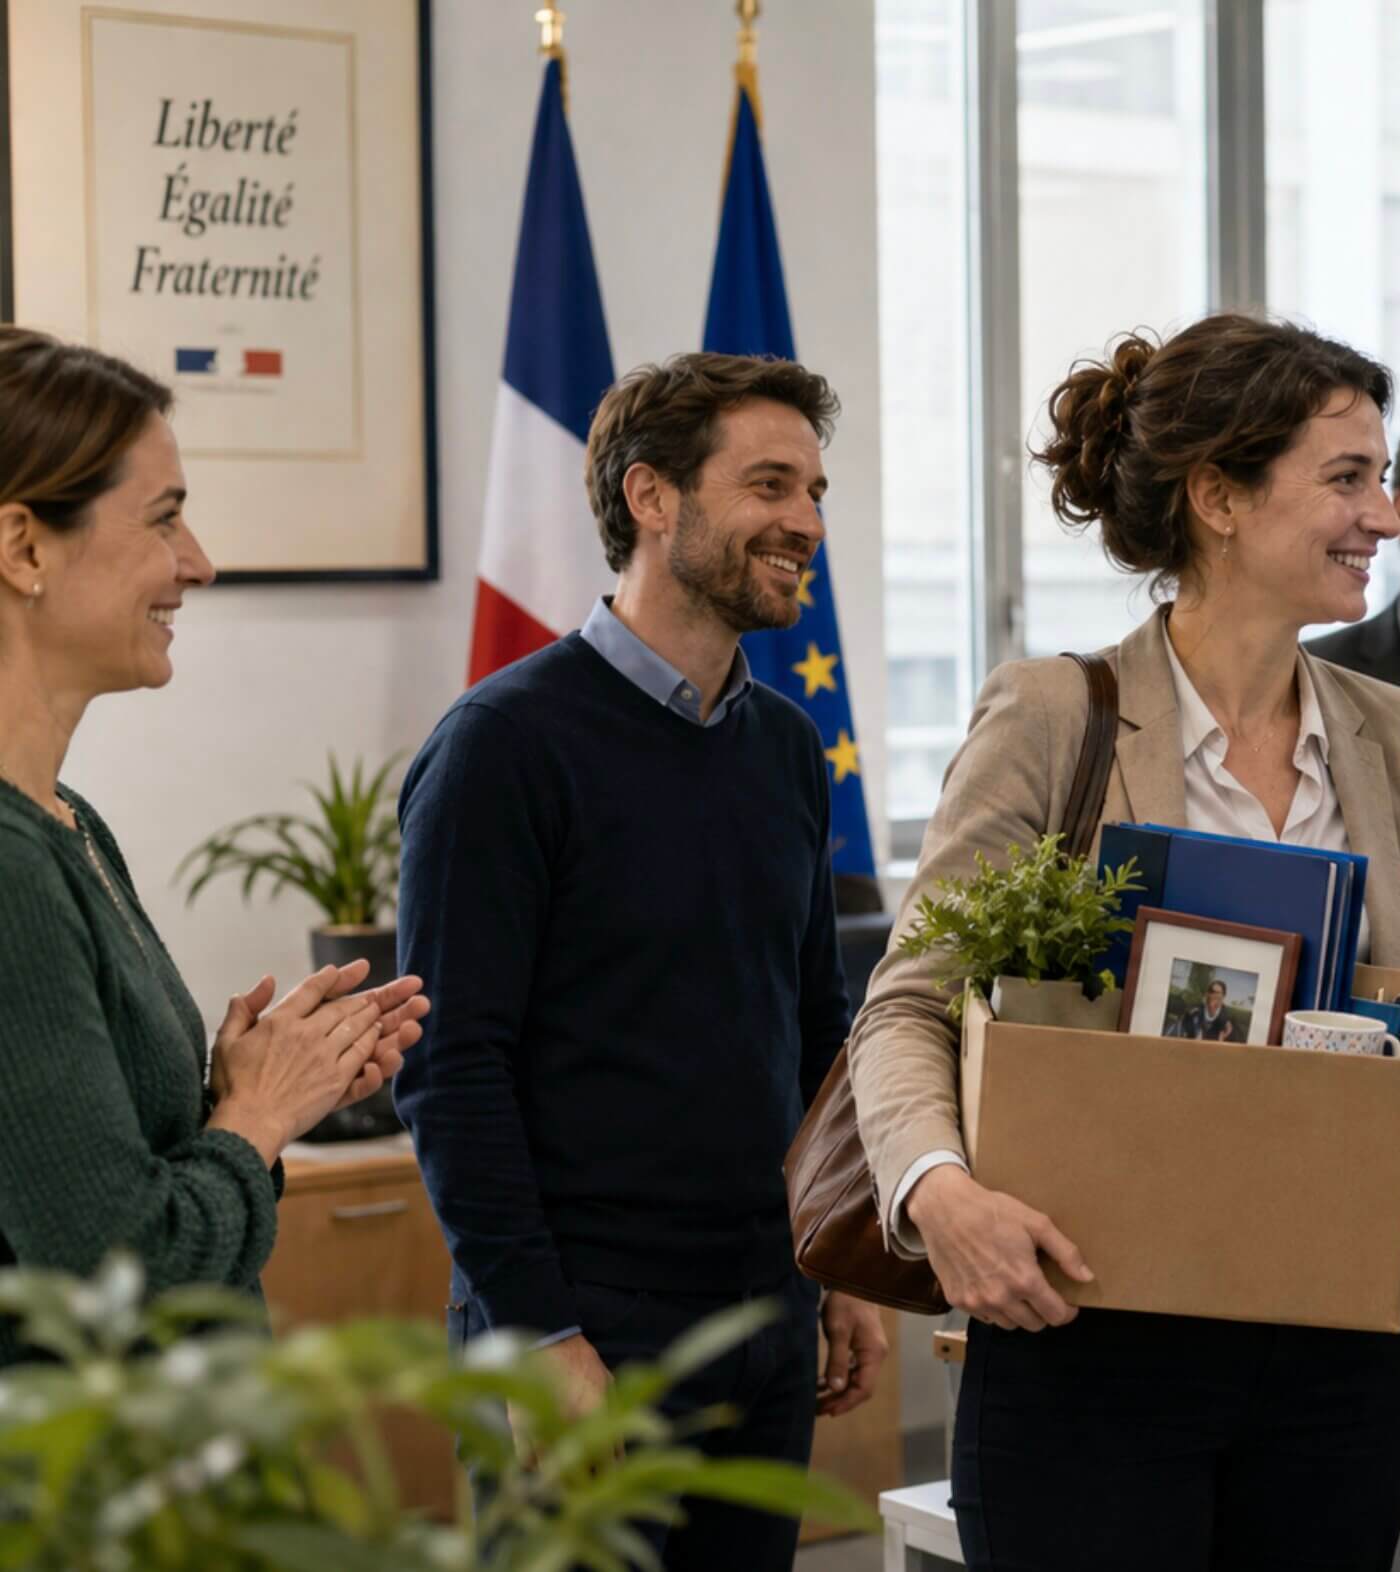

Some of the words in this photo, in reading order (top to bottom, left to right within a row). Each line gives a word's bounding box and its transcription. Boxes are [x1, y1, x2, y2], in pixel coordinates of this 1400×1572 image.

[153, 98, 298, 156] Liberté
[158, 163, 295, 237] Égalité
[129, 246, 321, 301] Fraternité
